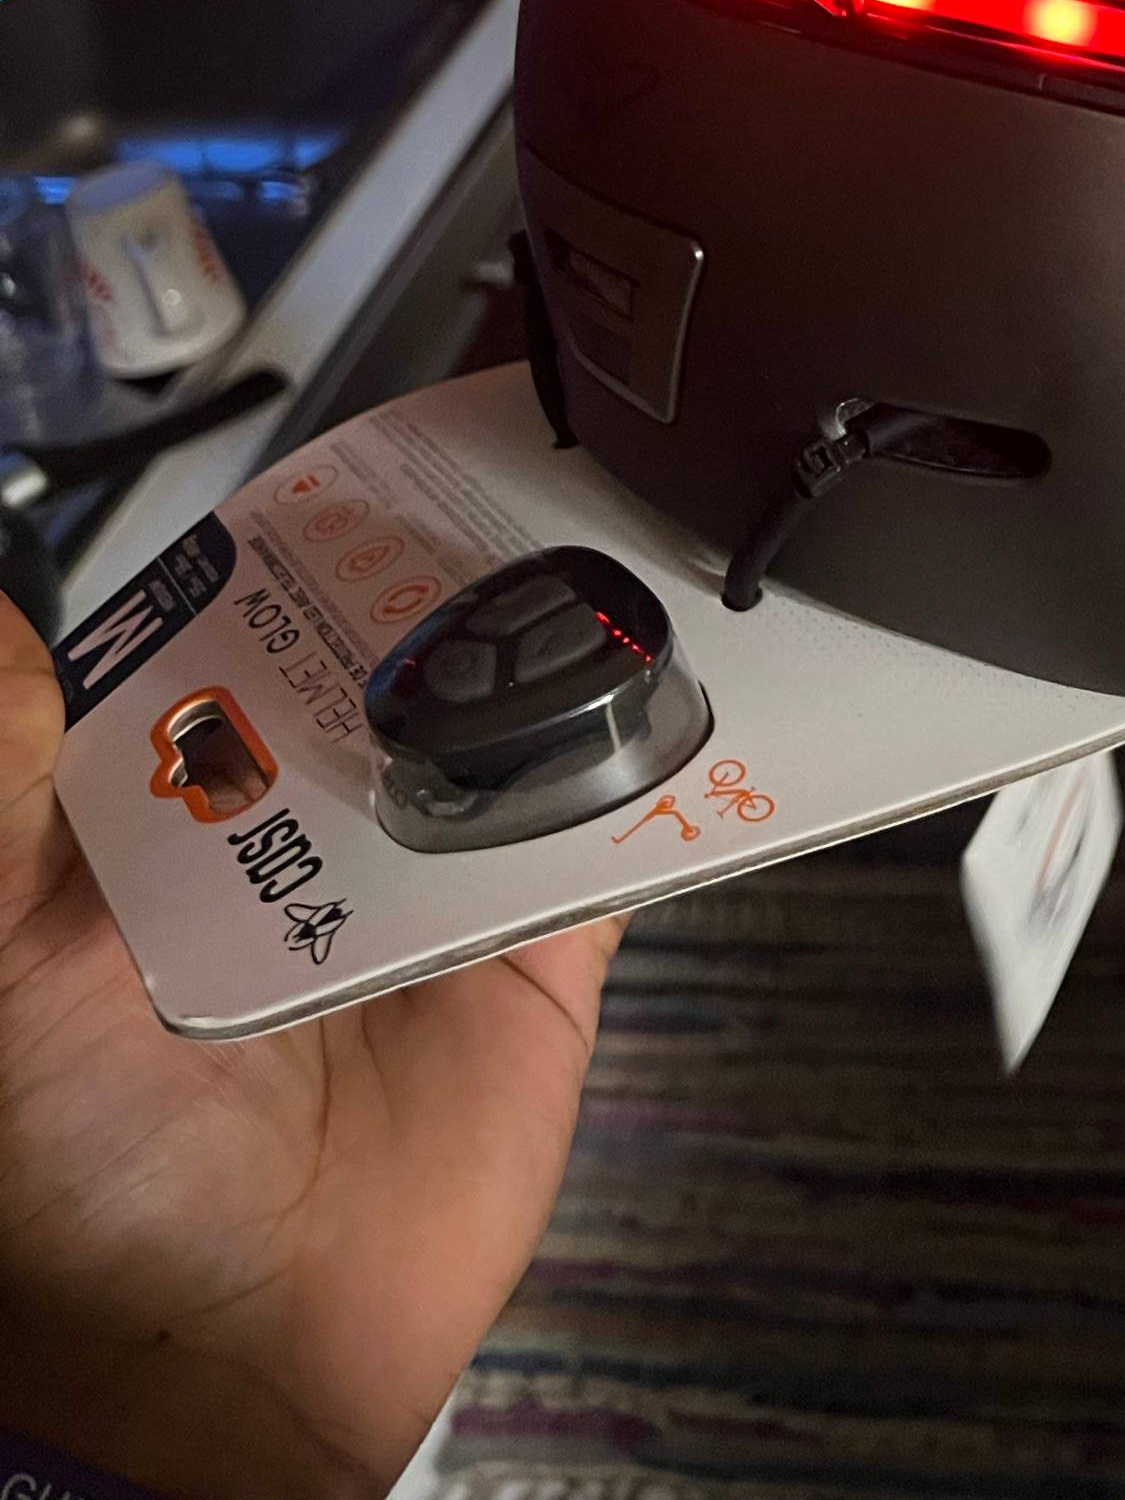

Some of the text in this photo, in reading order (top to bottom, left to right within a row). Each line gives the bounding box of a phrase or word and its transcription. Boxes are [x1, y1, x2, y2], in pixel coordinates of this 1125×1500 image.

[67, 588, 164, 690] M
[233, 587, 300, 654] GLOW
[279, 651, 364, 743] HELMET
[227, 807, 323, 903] casr
